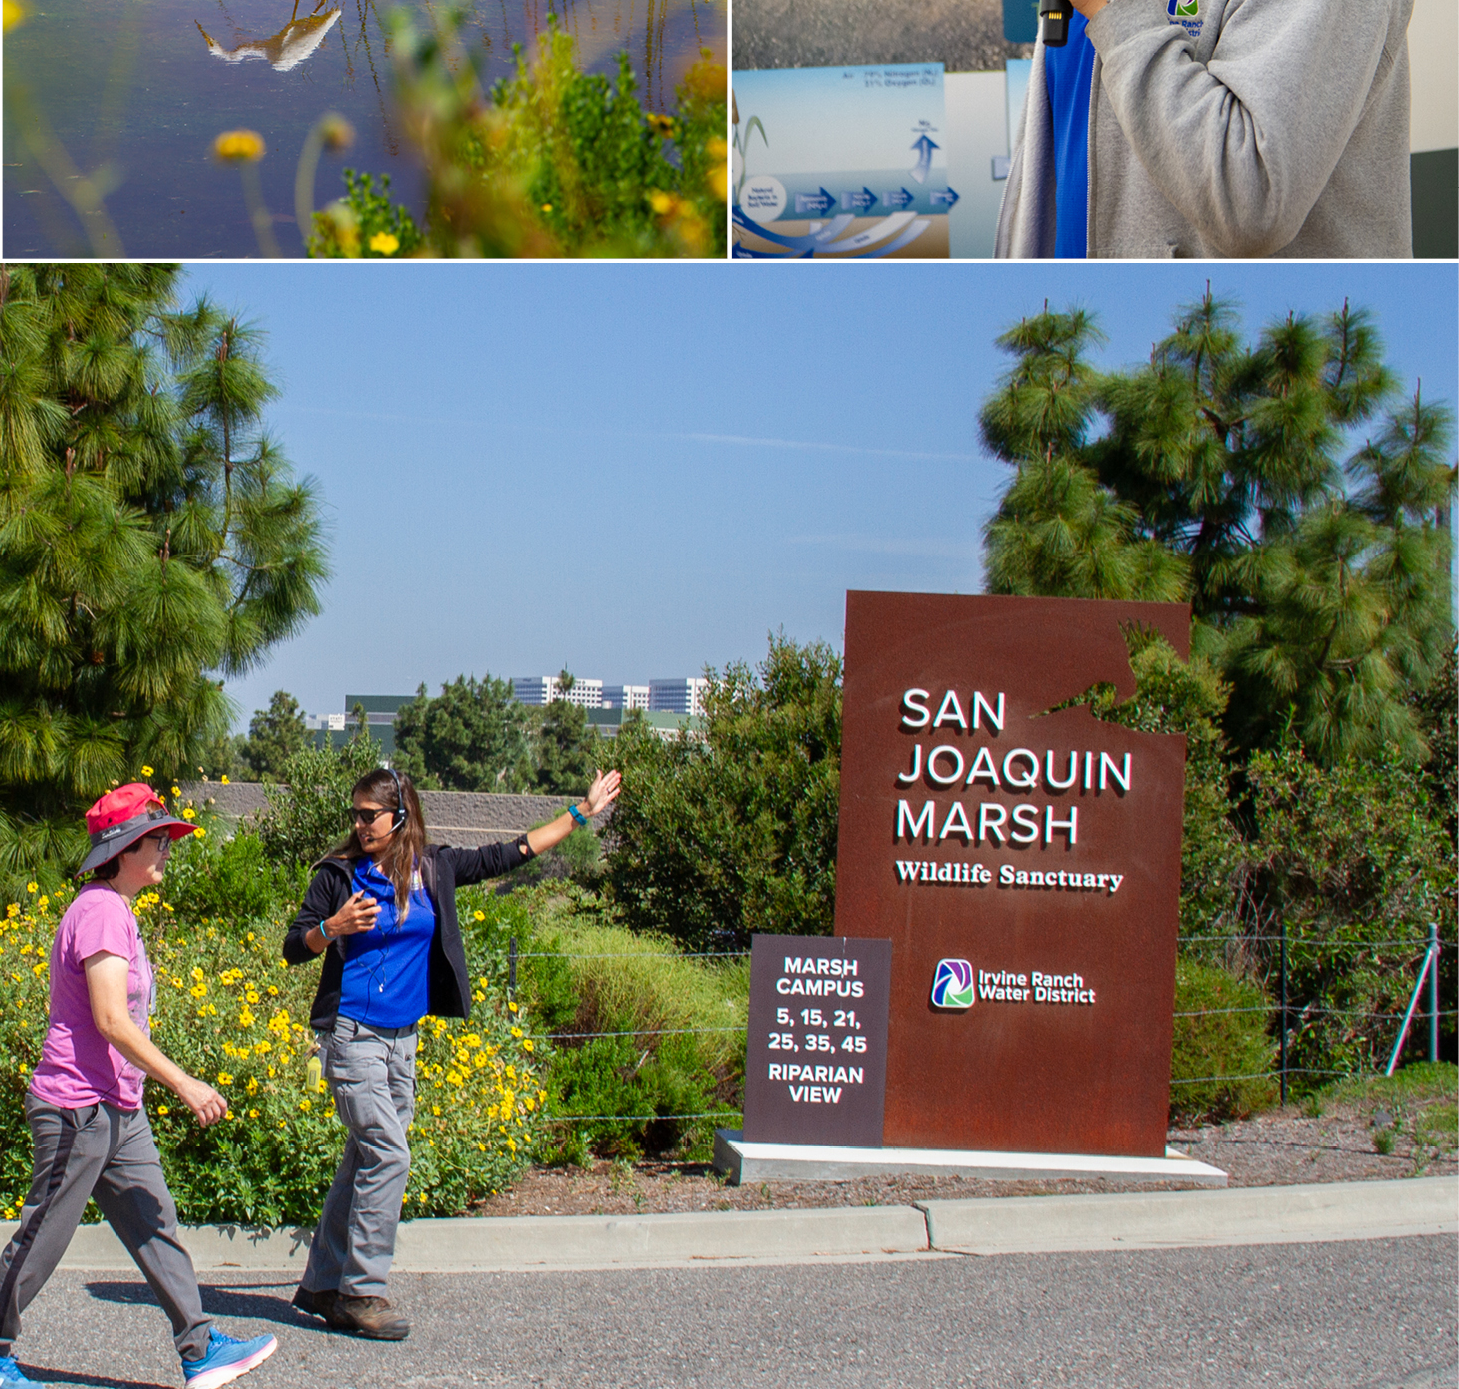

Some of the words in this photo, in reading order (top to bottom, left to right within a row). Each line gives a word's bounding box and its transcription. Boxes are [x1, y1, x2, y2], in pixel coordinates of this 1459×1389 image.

[902, 688, 1006, 730] SAN
[897, 744, 1132, 791] JOAQUIN
[896, 799, 1078, 844] MARSH
[896, 860, 992, 884] Wildlife
[999, 864, 1124, 893] Sanctuary
[784, 957, 858, 977] MARSH
[776, 978, 864, 998] CAMPUS
[978, 969, 1028, 987] Irvine
[1032, 971, 1084, 989] Ranch
[979, 984, 1030, 1001] Water
[1035, 986, 1096, 1004] District
[776, 1008, 795, 1027] 5,
[801, 1008, 827, 1028] 15,
[833, 1010, 861, 1029] 21,
[768, 1033, 799, 1053] 25,
[805, 1034, 836, 1054] 35,
[842, 1035, 867, 1054] 45
[769, 1063, 864, 1084] RIPARIAN
[788, 1085, 842, 1103] VIEW
